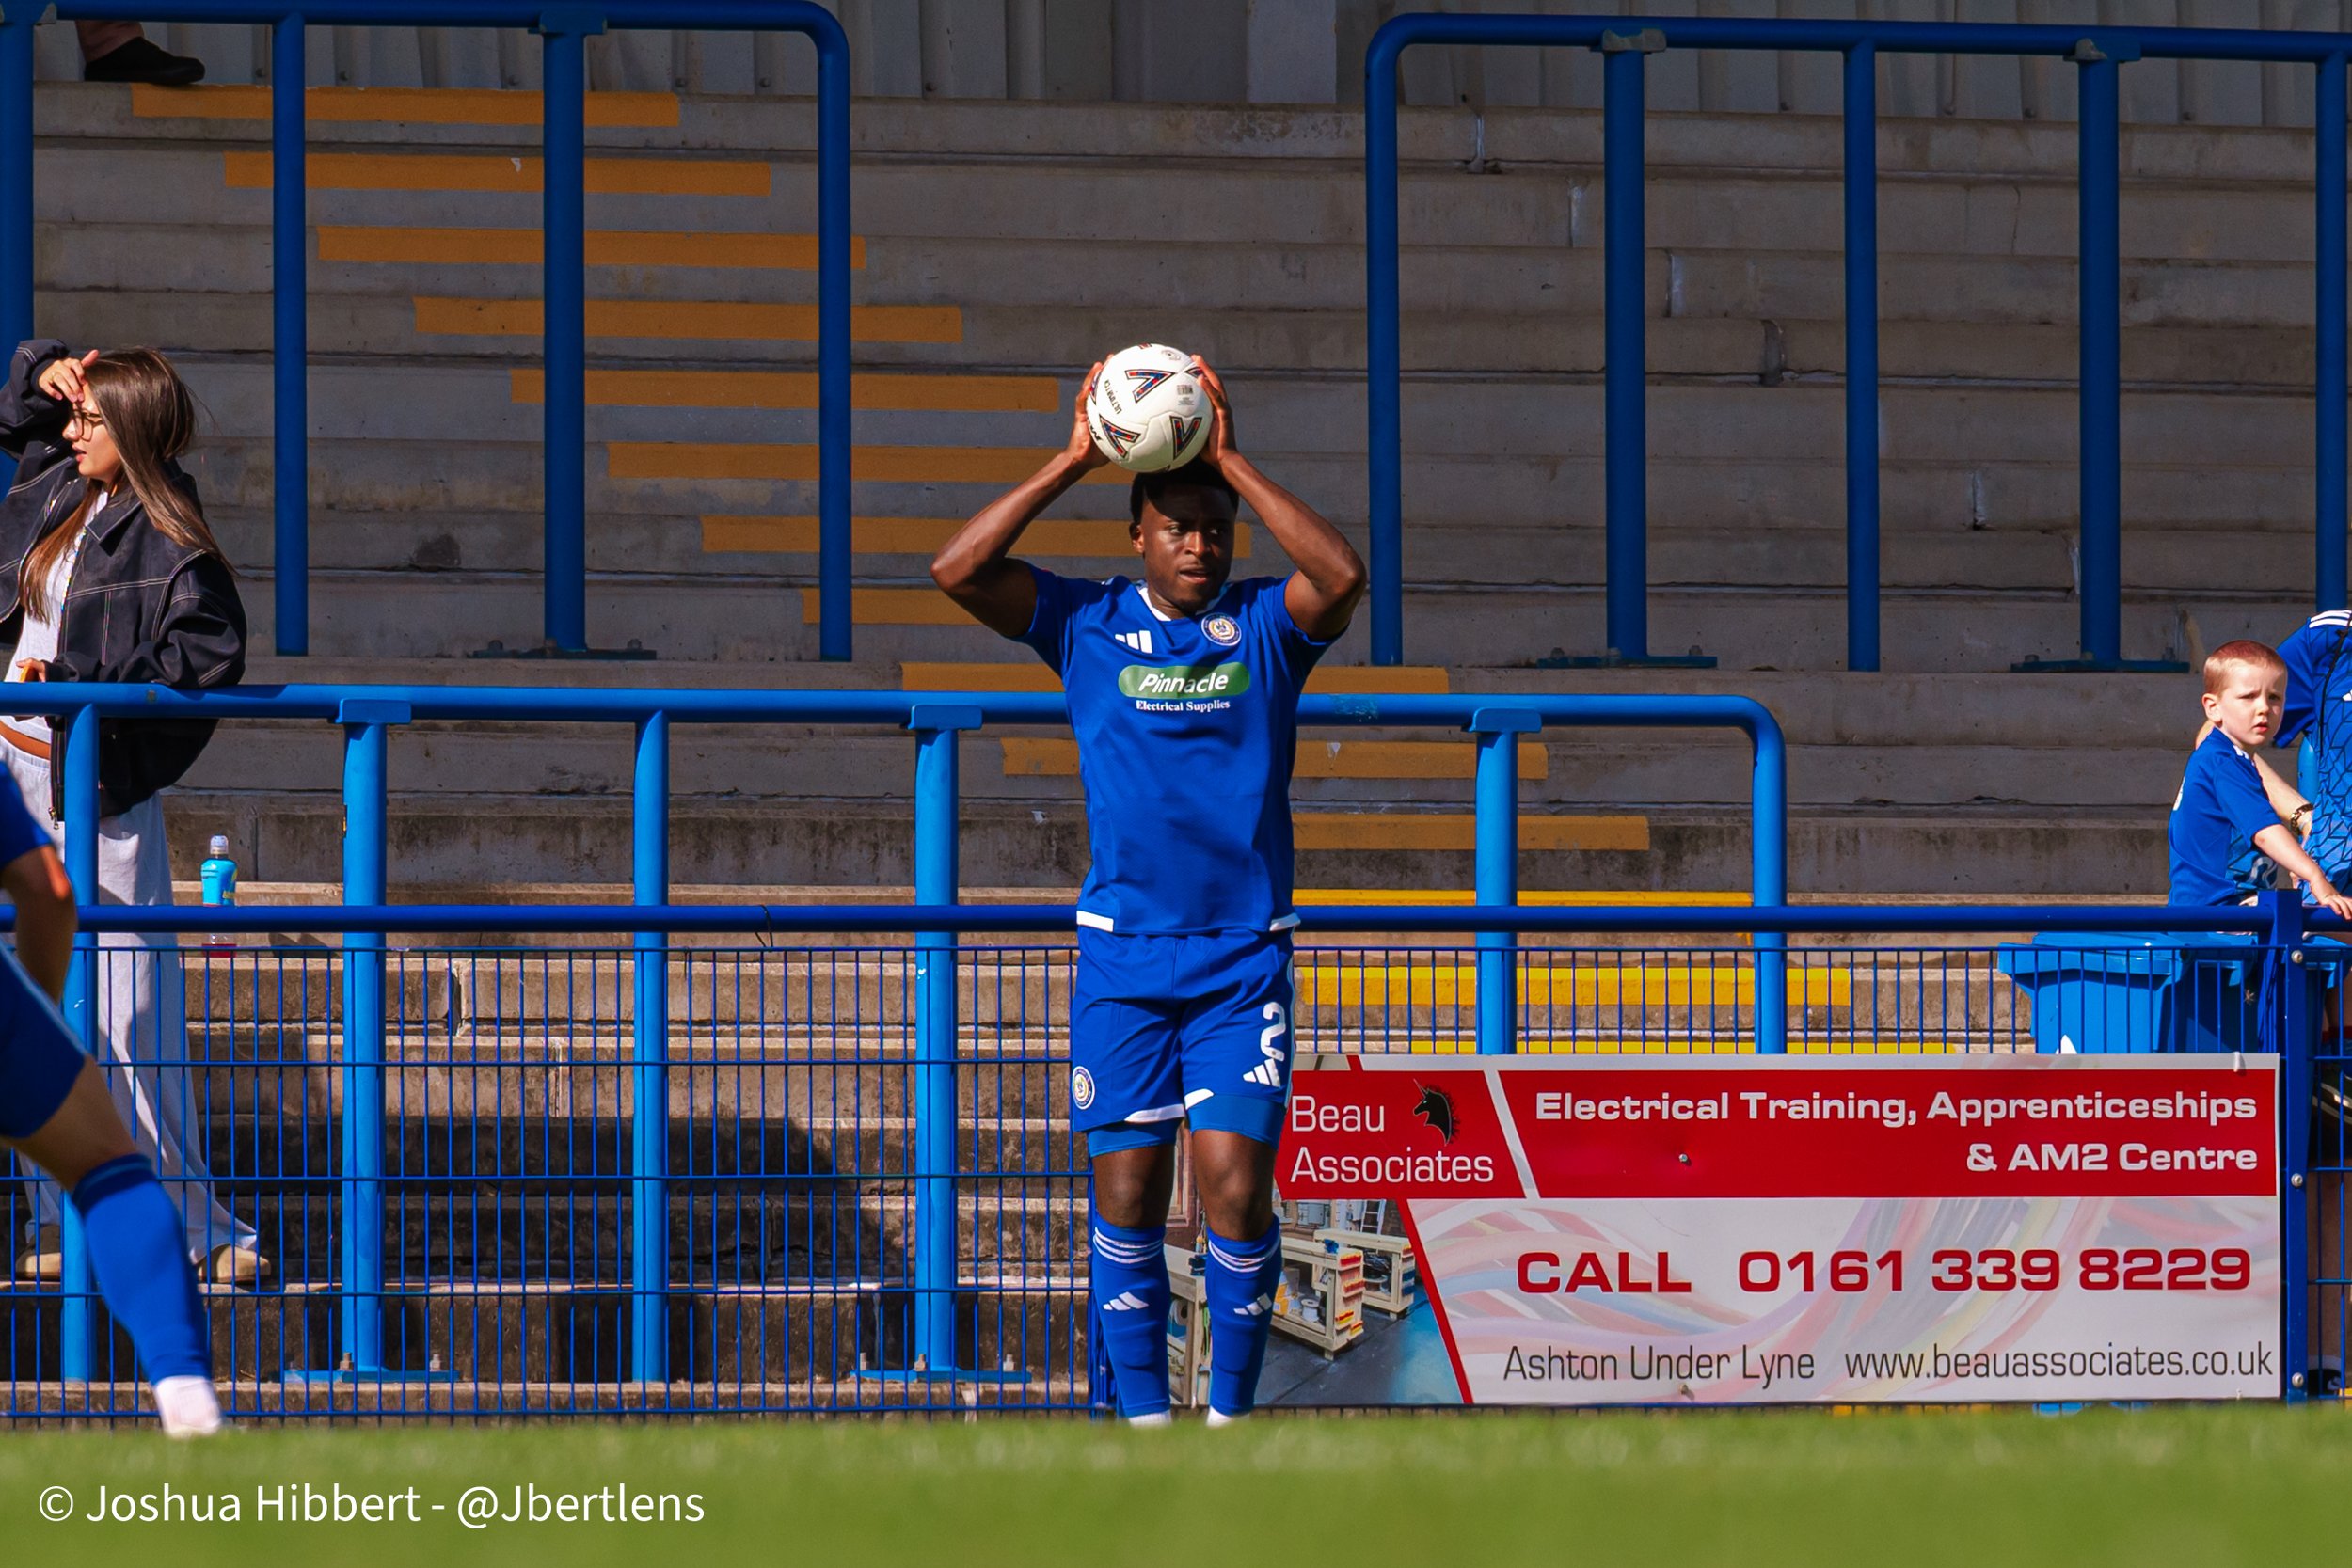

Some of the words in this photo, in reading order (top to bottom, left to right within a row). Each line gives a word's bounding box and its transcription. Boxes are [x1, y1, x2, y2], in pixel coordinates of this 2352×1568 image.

[1138, 673, 1229, 693] Pinnacle
[1136, 699, 1184, 711] Electrical
[1185, 699, 1231, 713] Supplies
[1261, 1001, 1286, 1062] 2
[1291, 1095, 1385, 1132] Beau
[1536, 1092, 1728, 1120] Electrical
[1740, 1092, 1916, 1127] Training,
[1927, 1091, 2257, 1127] Apprenticeships
[1290, 1146, 1494, 1183] Associates
[1966, 1144, 1998, 1172] &
[2008, 1144, 2108, 1171] AM2
[2119, 1144, 2258, 1171] Centre
[1517, 1251, 1692, 1293] CALL
[1739, 1250, 1902, 1292] 0161
[1931, 1249, 2060, 1291] 339
[2079, 1248, 2250, 1291] 8229
[1503, 1345, 1617, 1380] Ashton
[1630, 1345, 1730, 1380] Under
[1742, 1345, 1815, 1389] Lyne
[1845, 1341, 2273, 1379] www.beauassociates.co.uk
